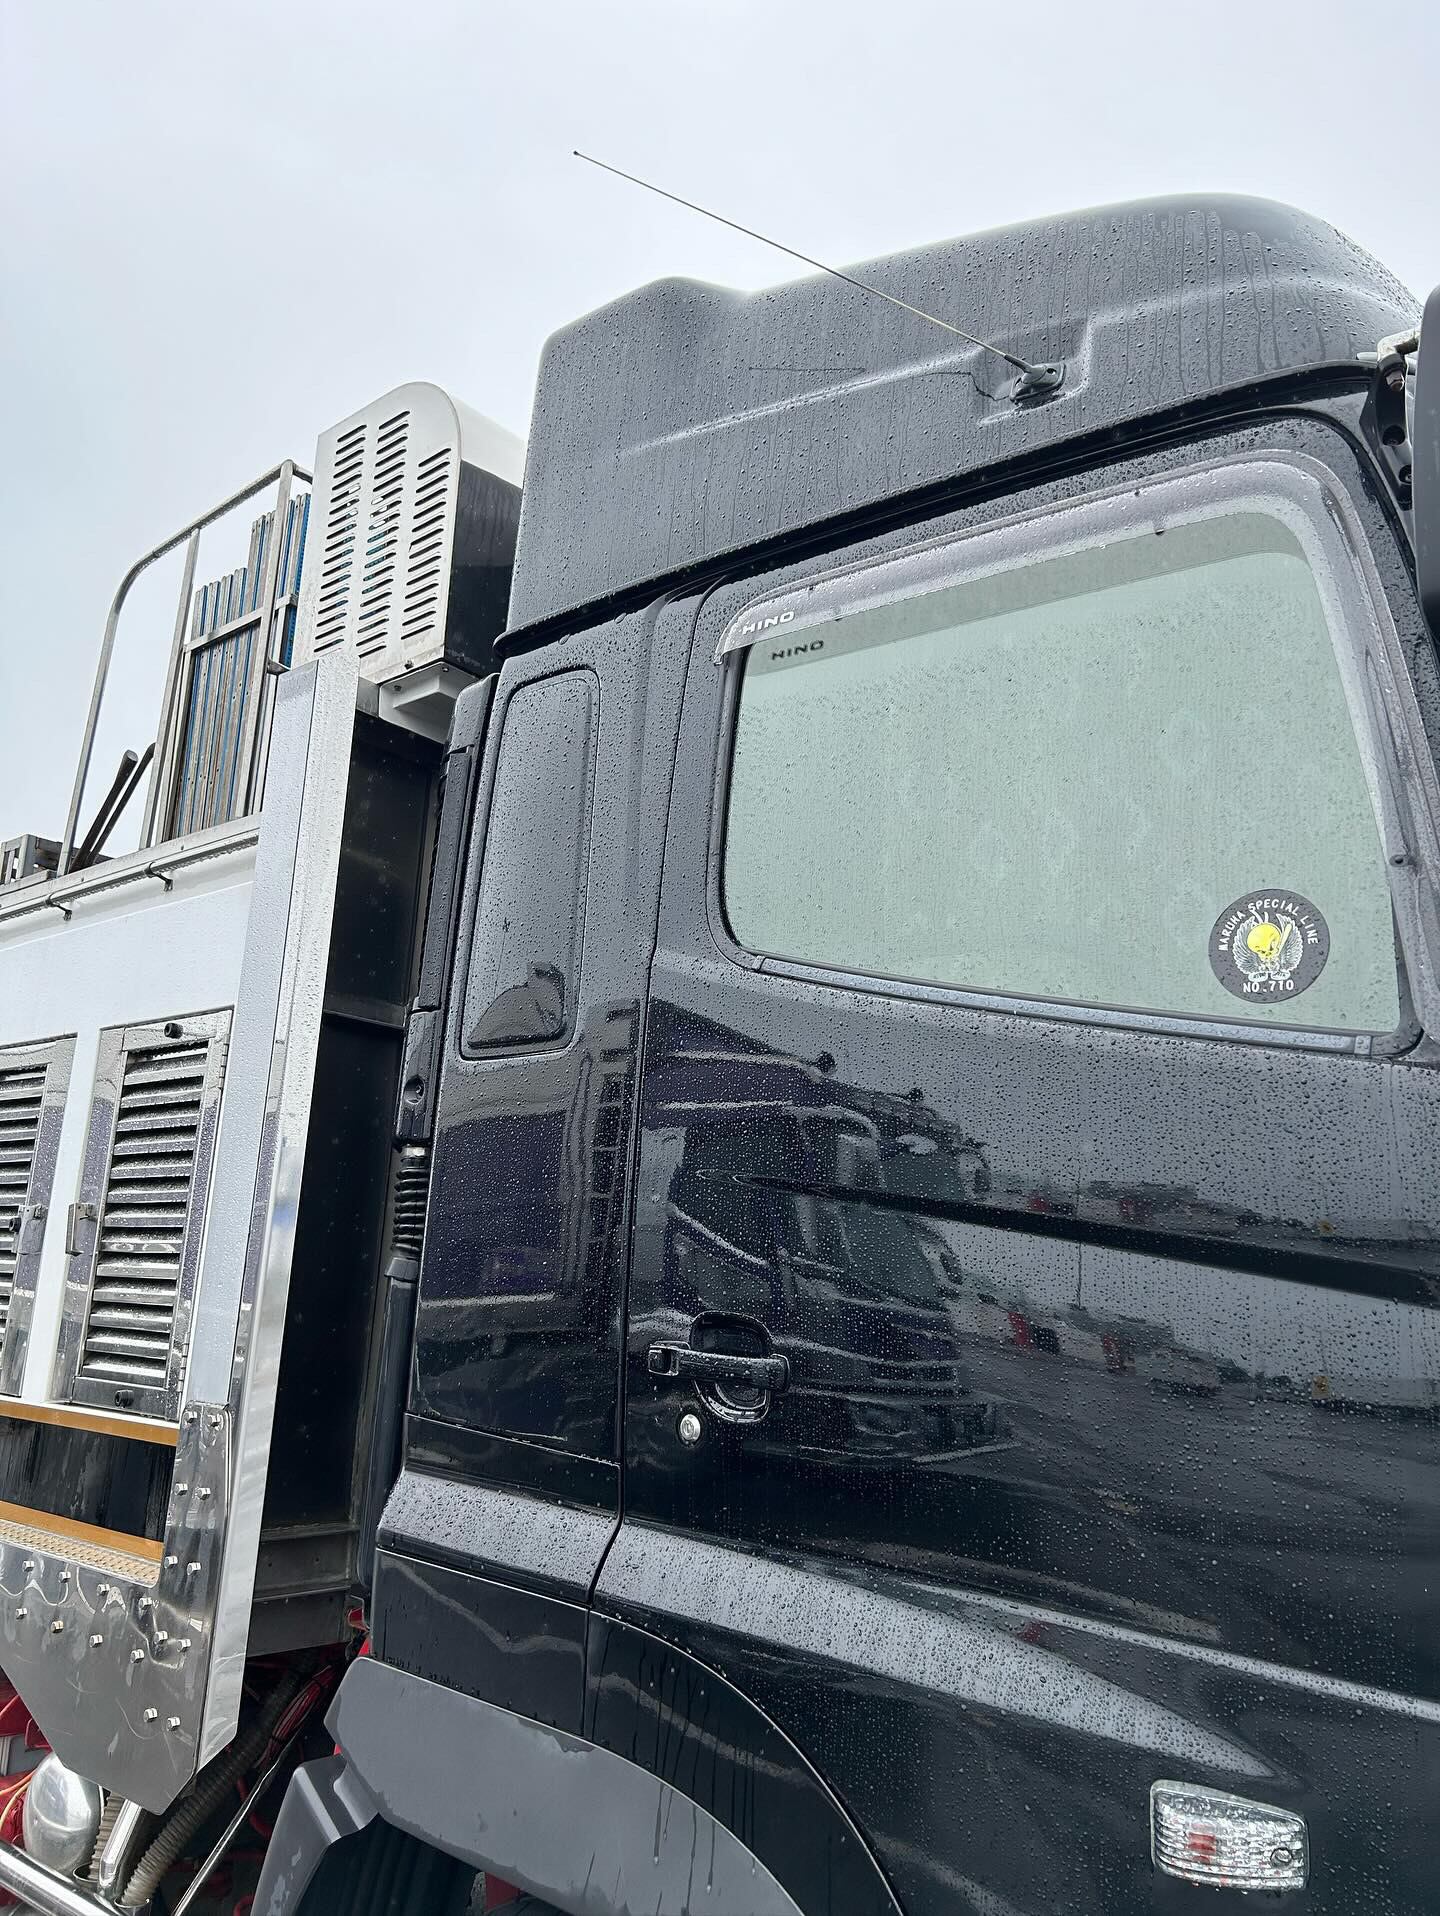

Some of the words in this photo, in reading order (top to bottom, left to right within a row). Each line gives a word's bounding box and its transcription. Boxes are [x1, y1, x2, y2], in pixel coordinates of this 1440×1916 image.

[742, 611, 795, 635] HINO
[771, 640, 824, 660] HINO
[1218, 910, 1246, 951] MARUHA
[1247, 899, 1300, 916] SPECIAL
[1300, 915, 1319, 945] LINE
